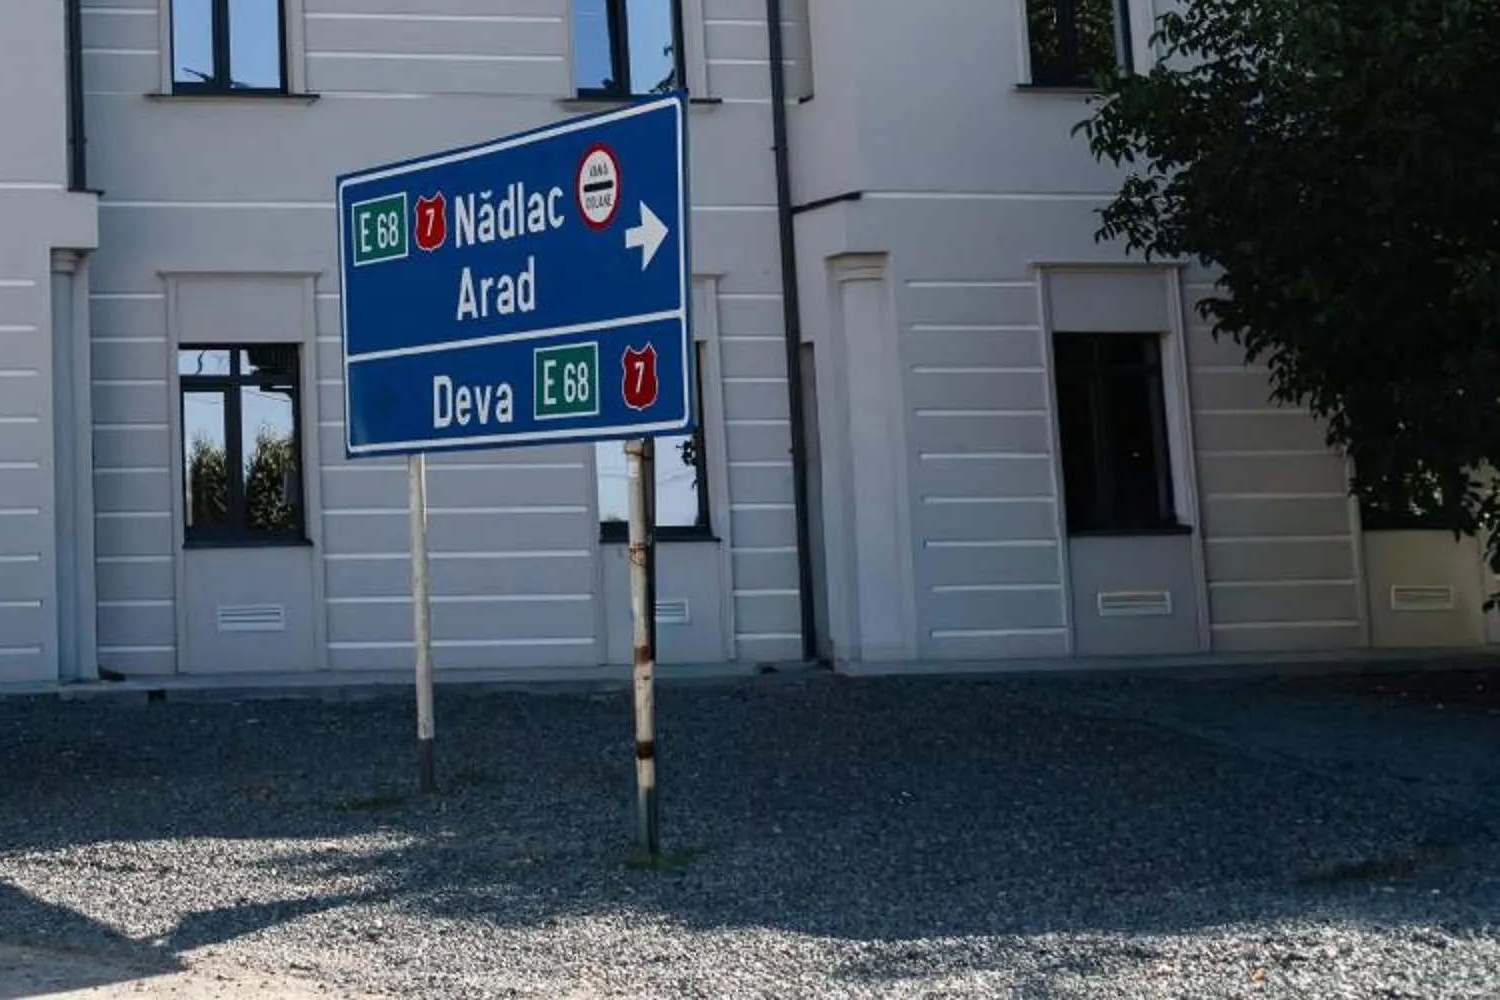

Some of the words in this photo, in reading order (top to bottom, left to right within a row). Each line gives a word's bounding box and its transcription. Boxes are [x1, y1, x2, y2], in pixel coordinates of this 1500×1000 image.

[359, 211, 372, 254] E
[376, 211, 400, 249] 68
[425, 207, 435, 238] 7
[454, 181, 565, 249] Nădlac
[456, 255, 536, 321] Arad
[543, 359, 557, 406] E
[563, 361, 590, 404] 68
[634, 361, 645, 394] 7
[433, 374, 514, 429] Deva
